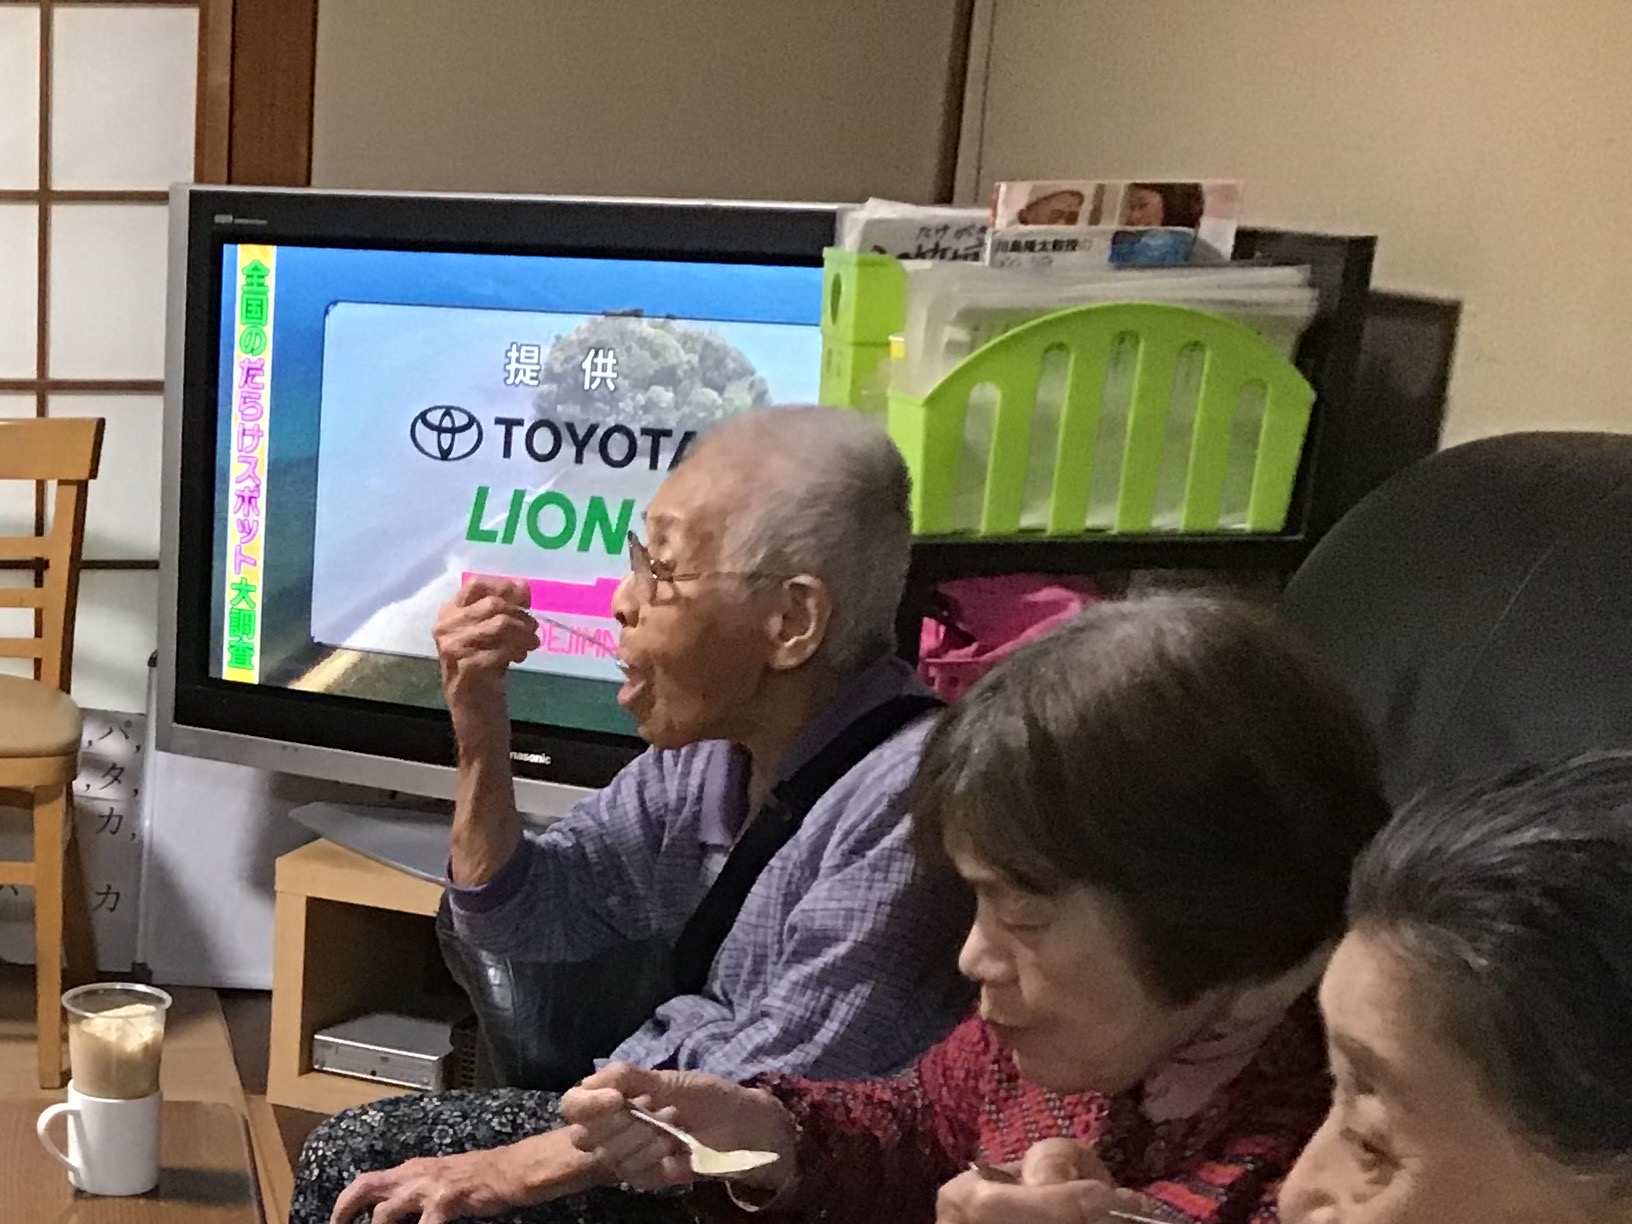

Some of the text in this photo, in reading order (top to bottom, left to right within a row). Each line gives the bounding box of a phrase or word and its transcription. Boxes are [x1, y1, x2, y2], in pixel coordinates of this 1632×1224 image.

[228, 259, 270, 670] 全国のだらけスポット大調査
[466, 486, 635, 555] LION
